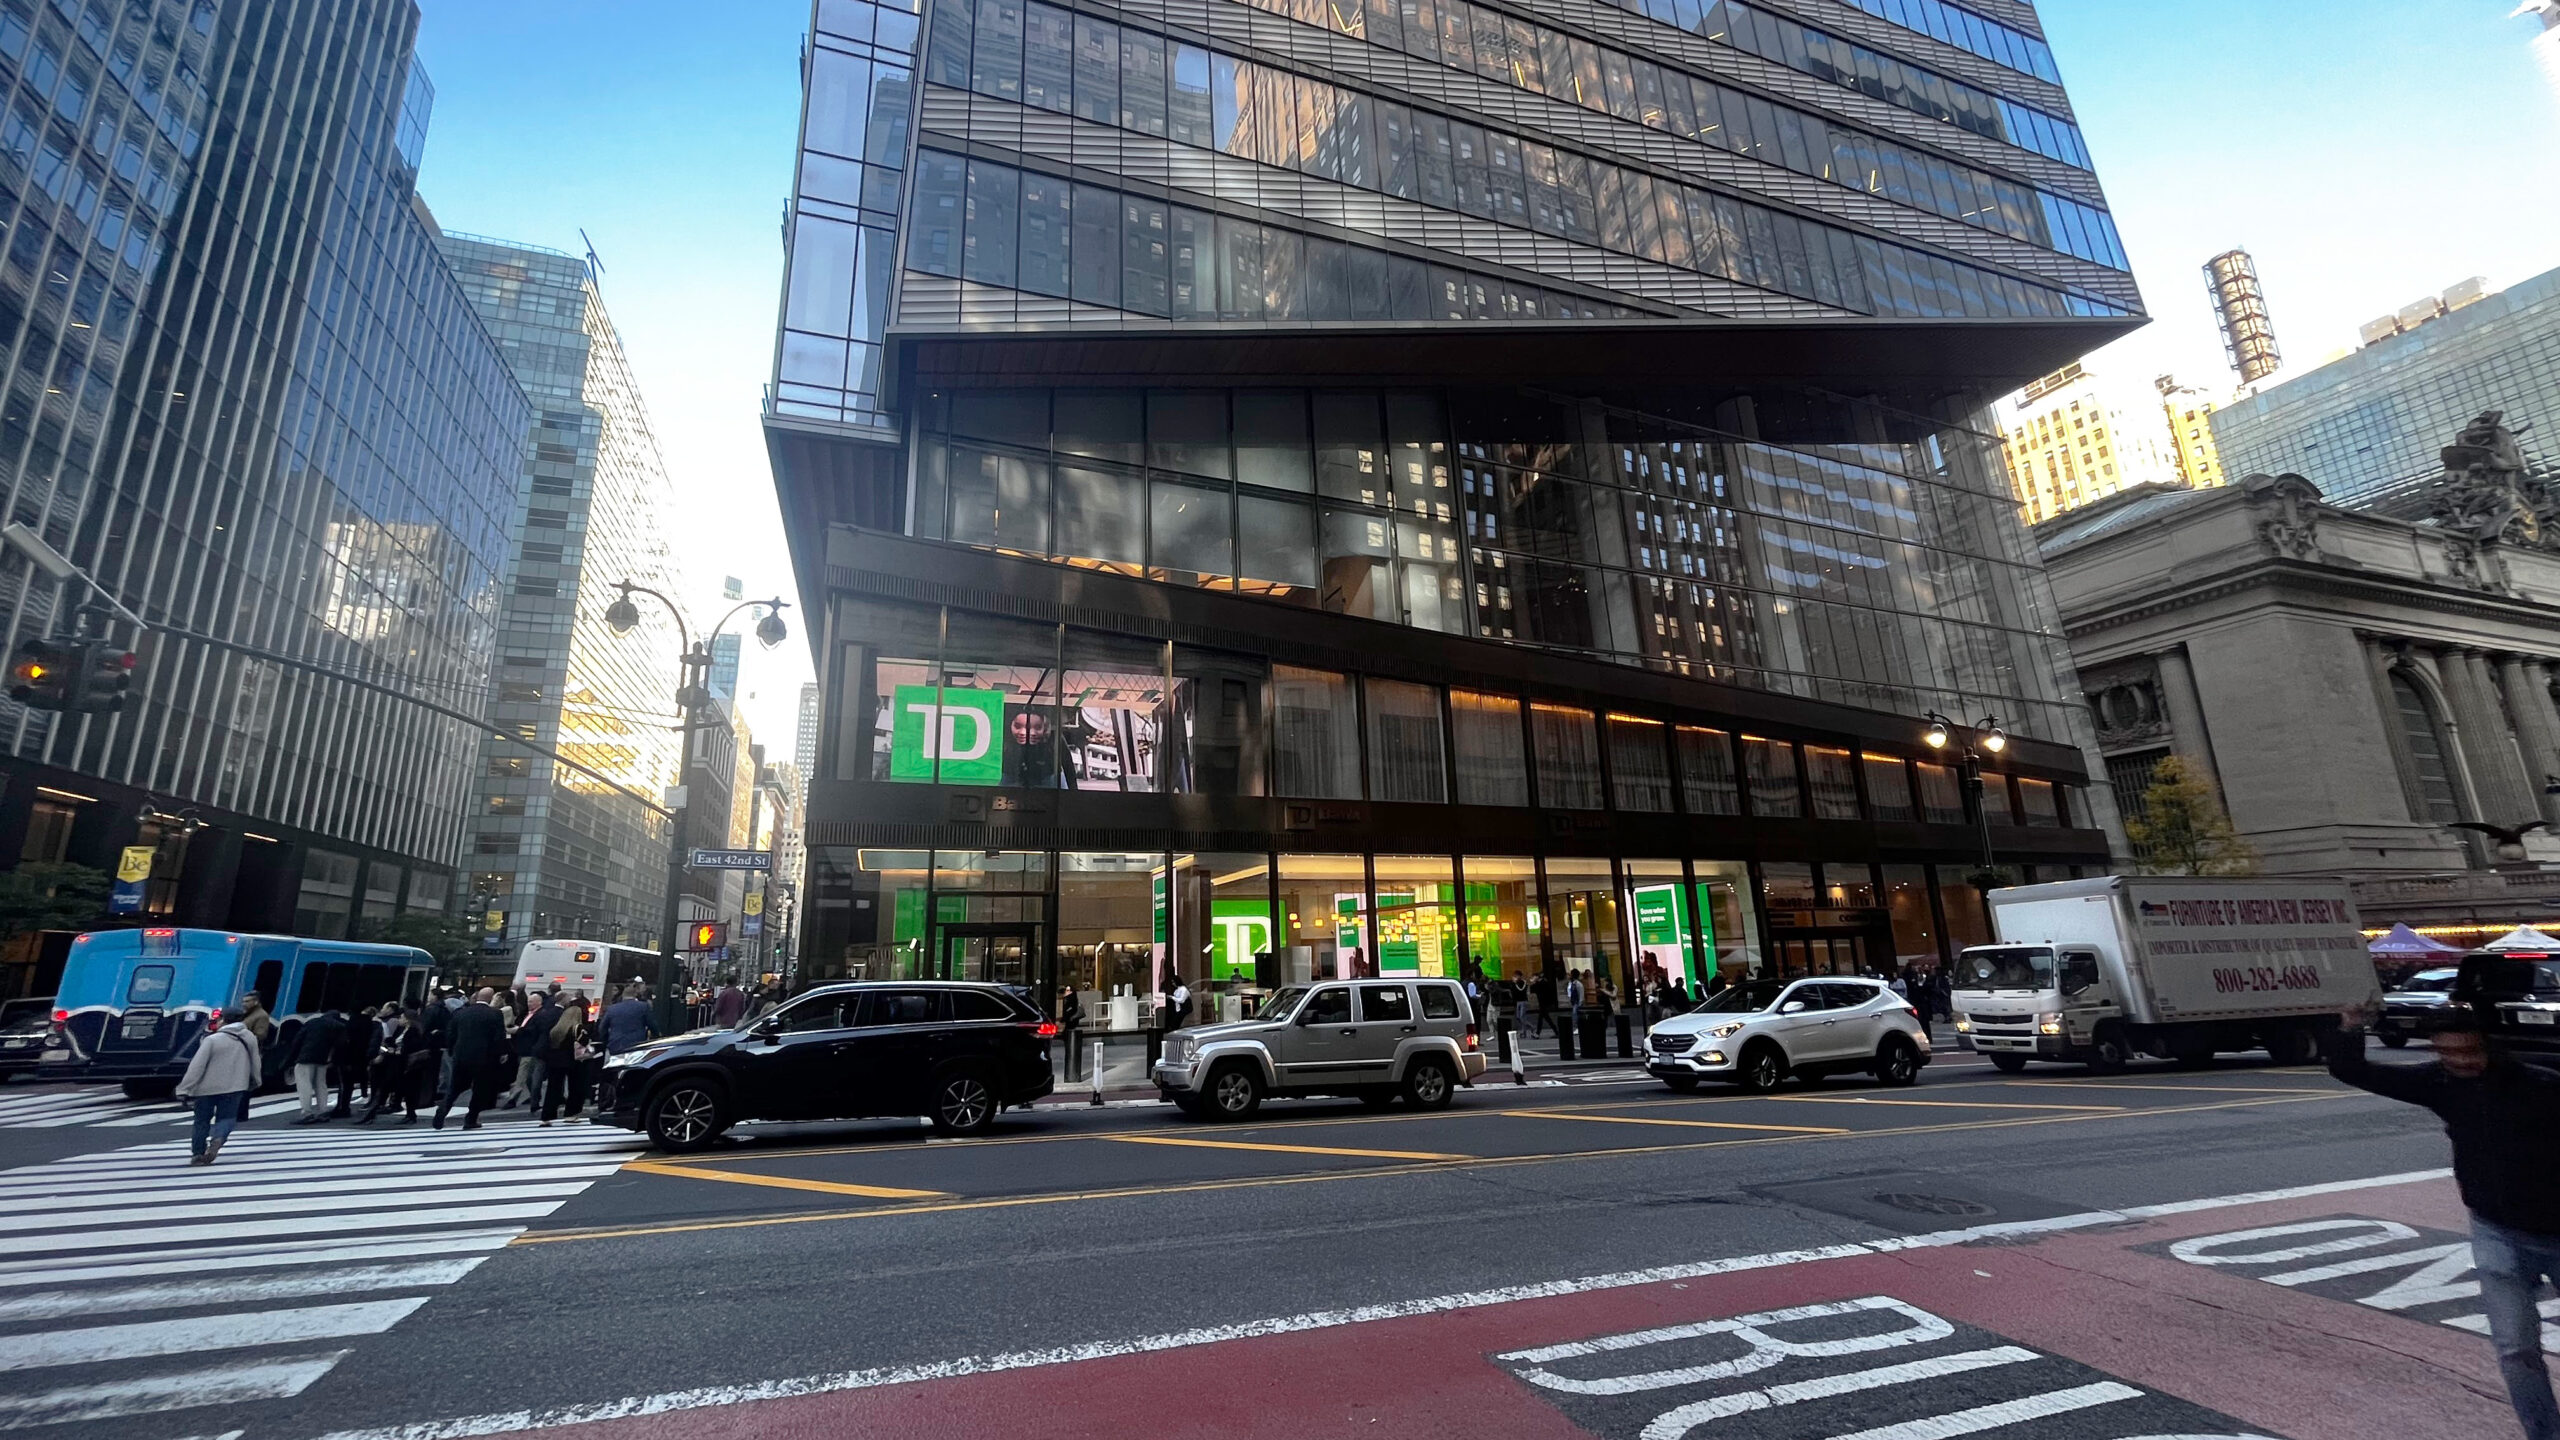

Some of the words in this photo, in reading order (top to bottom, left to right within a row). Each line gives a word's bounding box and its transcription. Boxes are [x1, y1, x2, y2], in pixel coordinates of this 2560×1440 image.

[907, 704, 992, 760] TD
[123, 856, 149, 872] Be
[696, 854, 722, 864] East
[724, 854, 751, 865] 42nd
[754, 855, 767, 866] St
[747, 899, 761, 909] Be
[2168, 900, 2226, 927] FURNITURE
[2222, 900, 2237, 925] OF
[2236, 899, 2280, 925] AMERICA
[2278, 899, 2301, 924] NEW
[2301, 899, 2333, 924] JERSEY
[1212, 916, 1273, 964] TD
[2213, 965, 2320, 993] 800-282-6888
